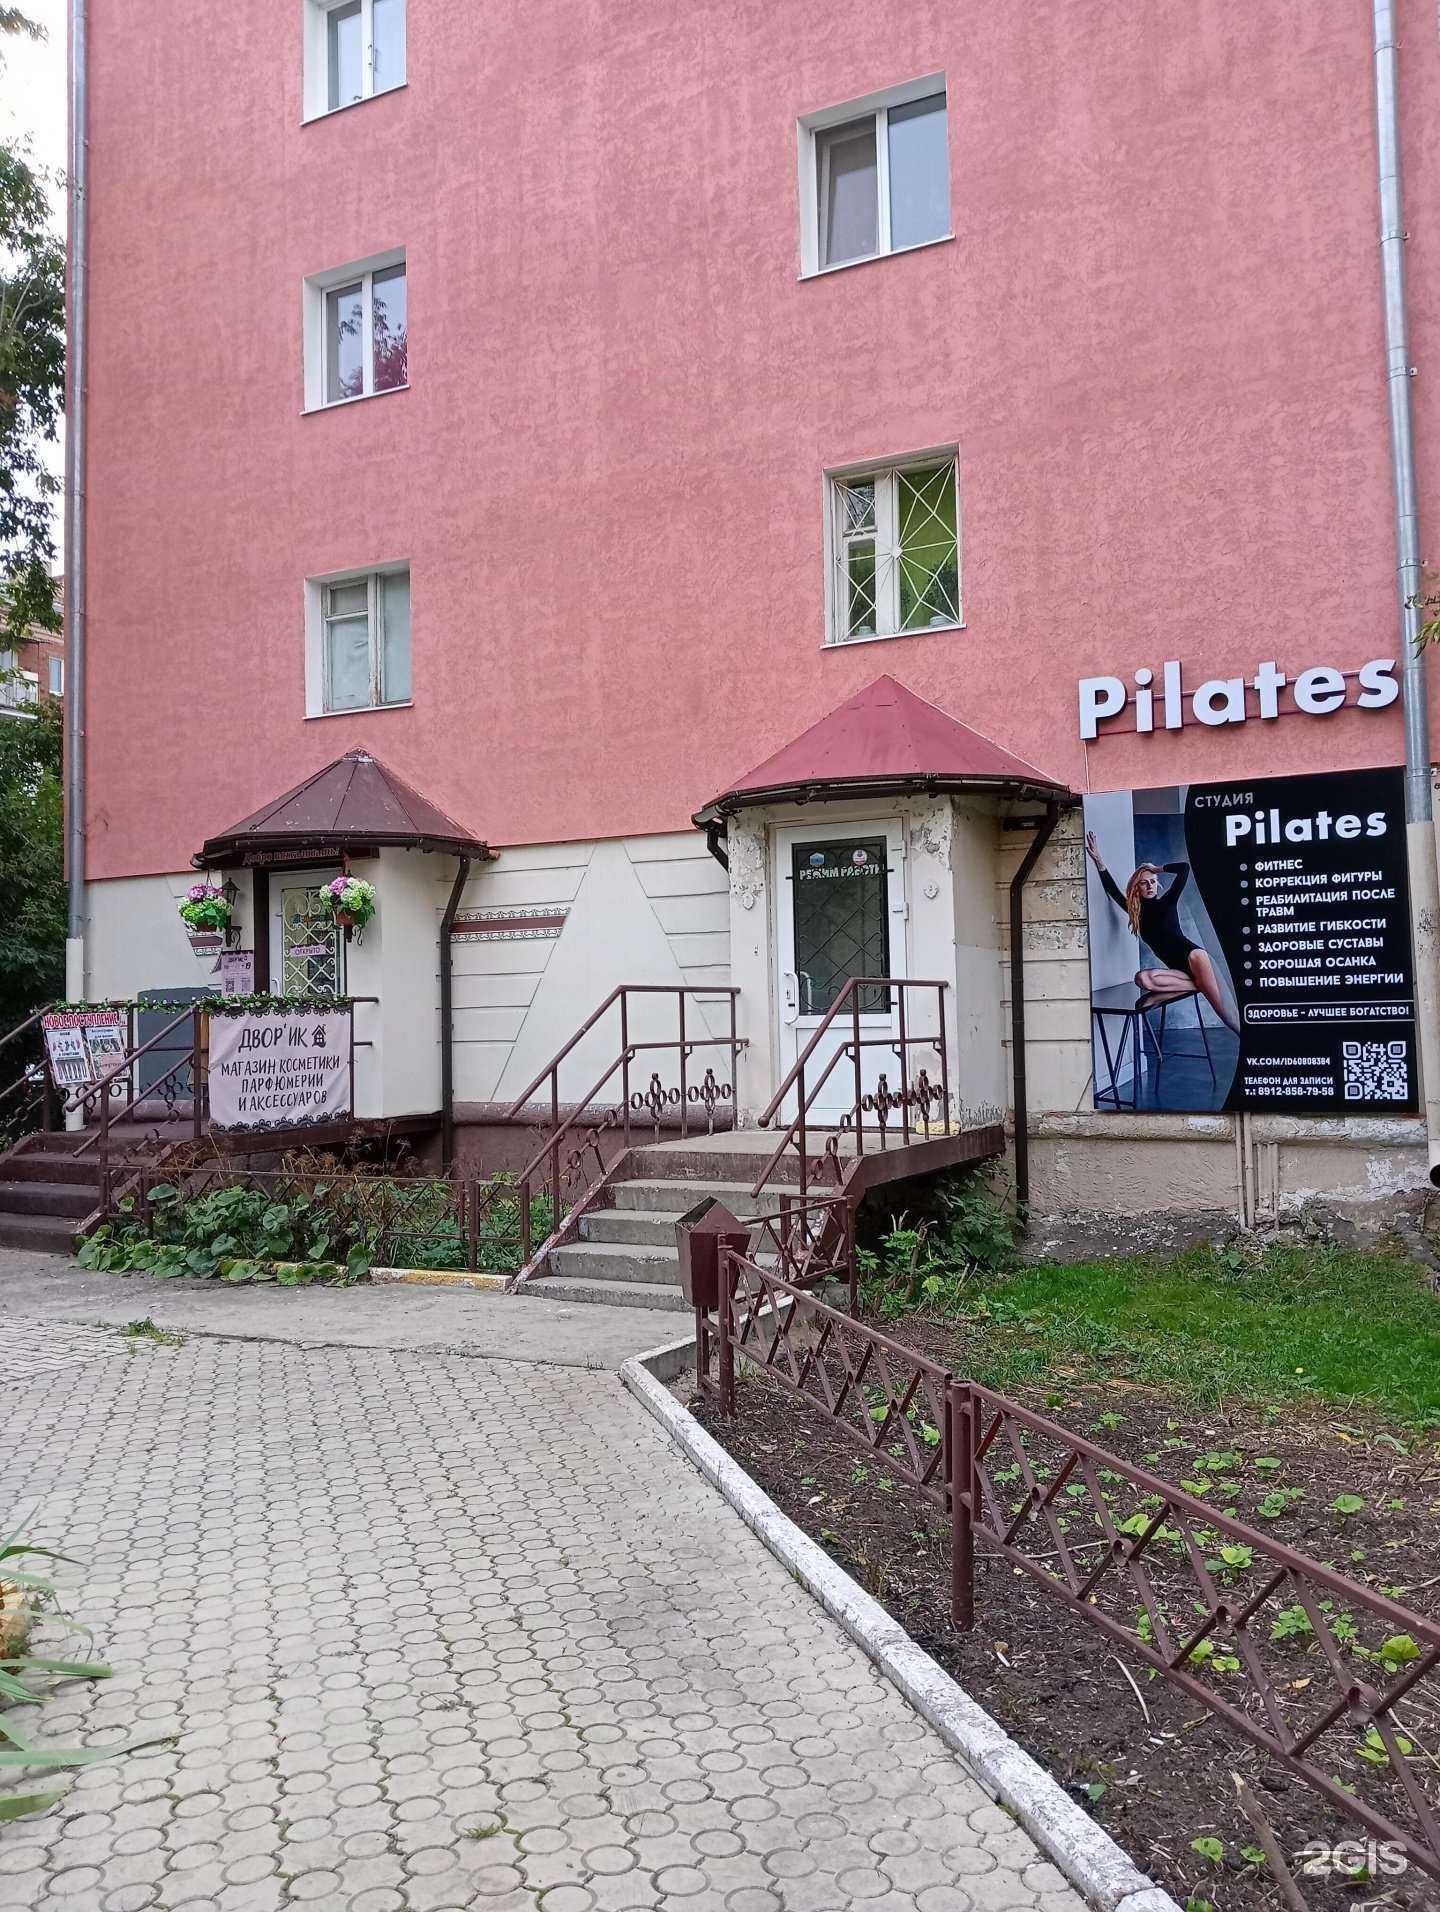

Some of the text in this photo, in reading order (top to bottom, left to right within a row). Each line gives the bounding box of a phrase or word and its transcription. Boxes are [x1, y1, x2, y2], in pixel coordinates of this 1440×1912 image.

[1078, 659, 1399, 740] Pilates
[1194, 792, 1254, 808] СТУДИЯ
[1225, 808, 1387, 847] Pilates
[1255, 859, 1303, 871] ФИТНЕС
[1255, 871, 1382, 888] КОРРЕКЦИЯ ФИГУРЫ
[1256, 888, 1395, 906] РЕАБИЛИТАЦИЯ ПОСЛЕ
[1256, 906, 1294, 917] ТРАВМ
[1257, 918, 1387, 934] РАЗВИТИЕ ГИБКОСТИ
[1258, 937, 1383, 952] ЗДОРОВЫЕ СУСТАВЫ
[1259, 956, 1376, 970] ХОРОШАЯ ОСАНКА
[1259, 973, 1404, 987] ПОВЫШЕНИЕ ЭНЕРГИИ
[1248, 1009, 1299, 1019] ЗДОРОВЬЕ
[1308, 1007, 1347, 1017] ЛУЧШЕЕ
[1350, 1006, 1409, 1016] БОГАТСТВО!
[221, 1056, 340, 1077] МАГАЗИН КОСМЕТИКИ
[241, 1073, 324, 1093] ПАРФЮМЕРИИ
[1244, 1076, 1333, 1086] ТЕЛЕФОН ДЛЯ ЗАПИСИ
[238, 1090, 328, 1112] И АКСЕССУАРОВ
